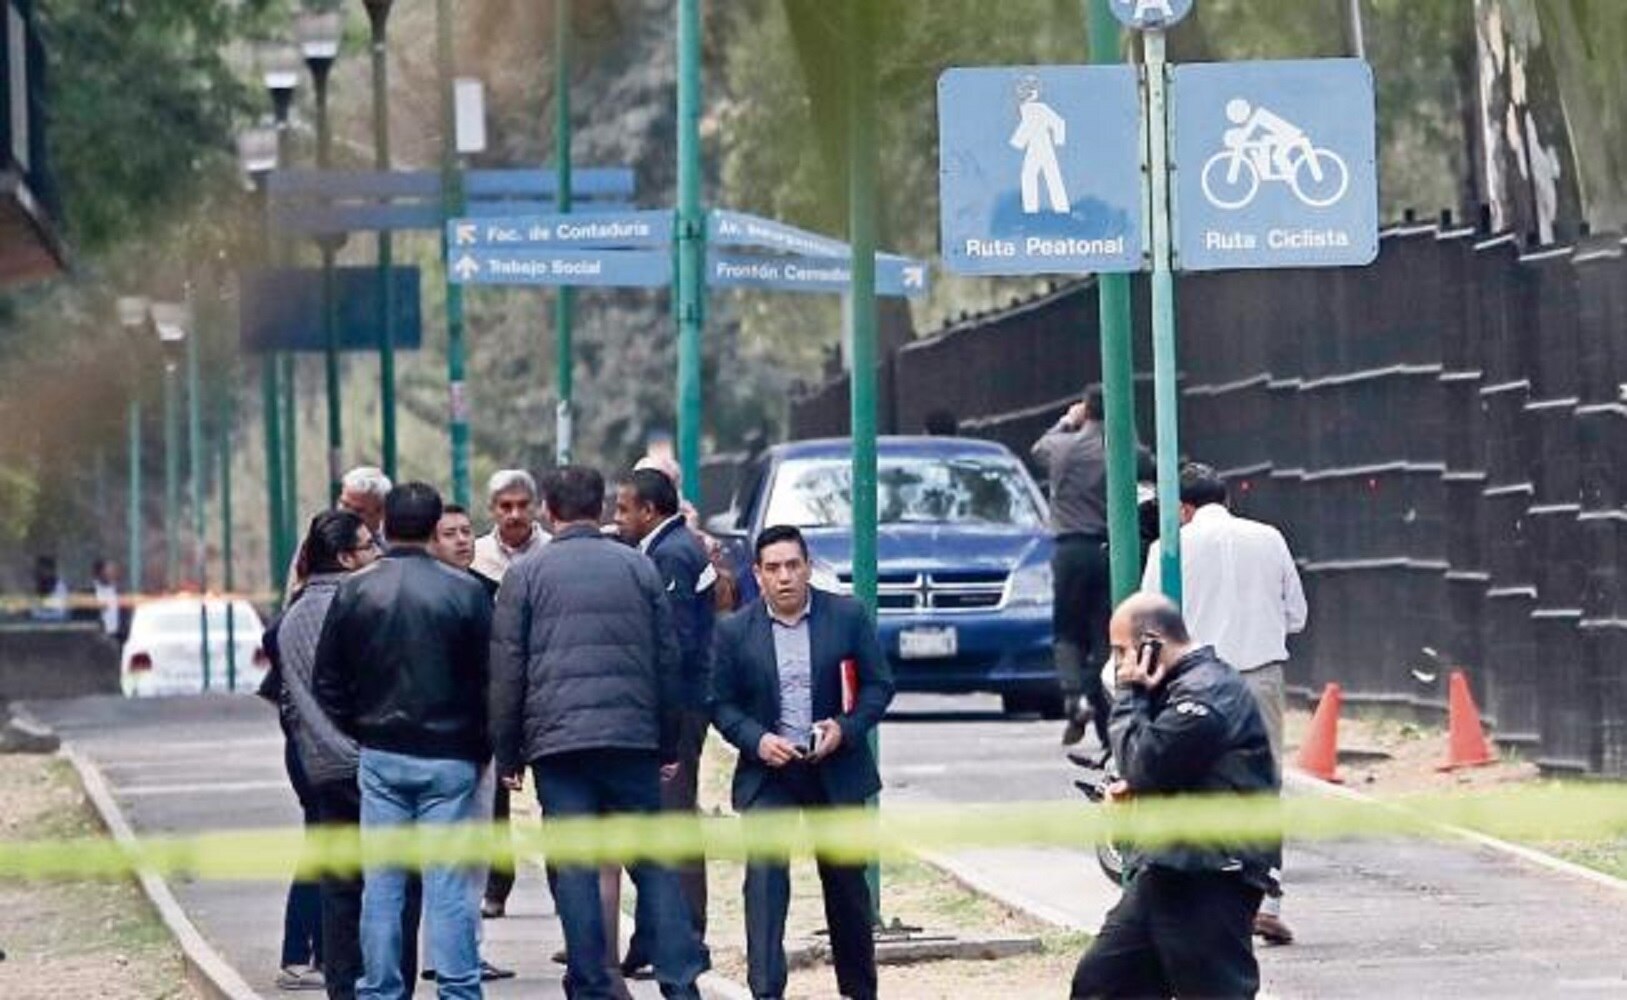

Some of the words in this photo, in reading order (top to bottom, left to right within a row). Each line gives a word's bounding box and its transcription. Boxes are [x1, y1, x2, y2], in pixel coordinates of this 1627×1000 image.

[529, 225, 550, 241] de
[1206, 231, 1256, 250] Ruta
[1266, 228, 1349, 249] Ciclista
[966, 239, 1016, 257] Ruta
[1026, 237, 1124, 256] Peatonal
[489, 259, 546, 279] Trabajo
[551, 259, 601, 274] Social
[716, 261, 778, 280] Frontón
